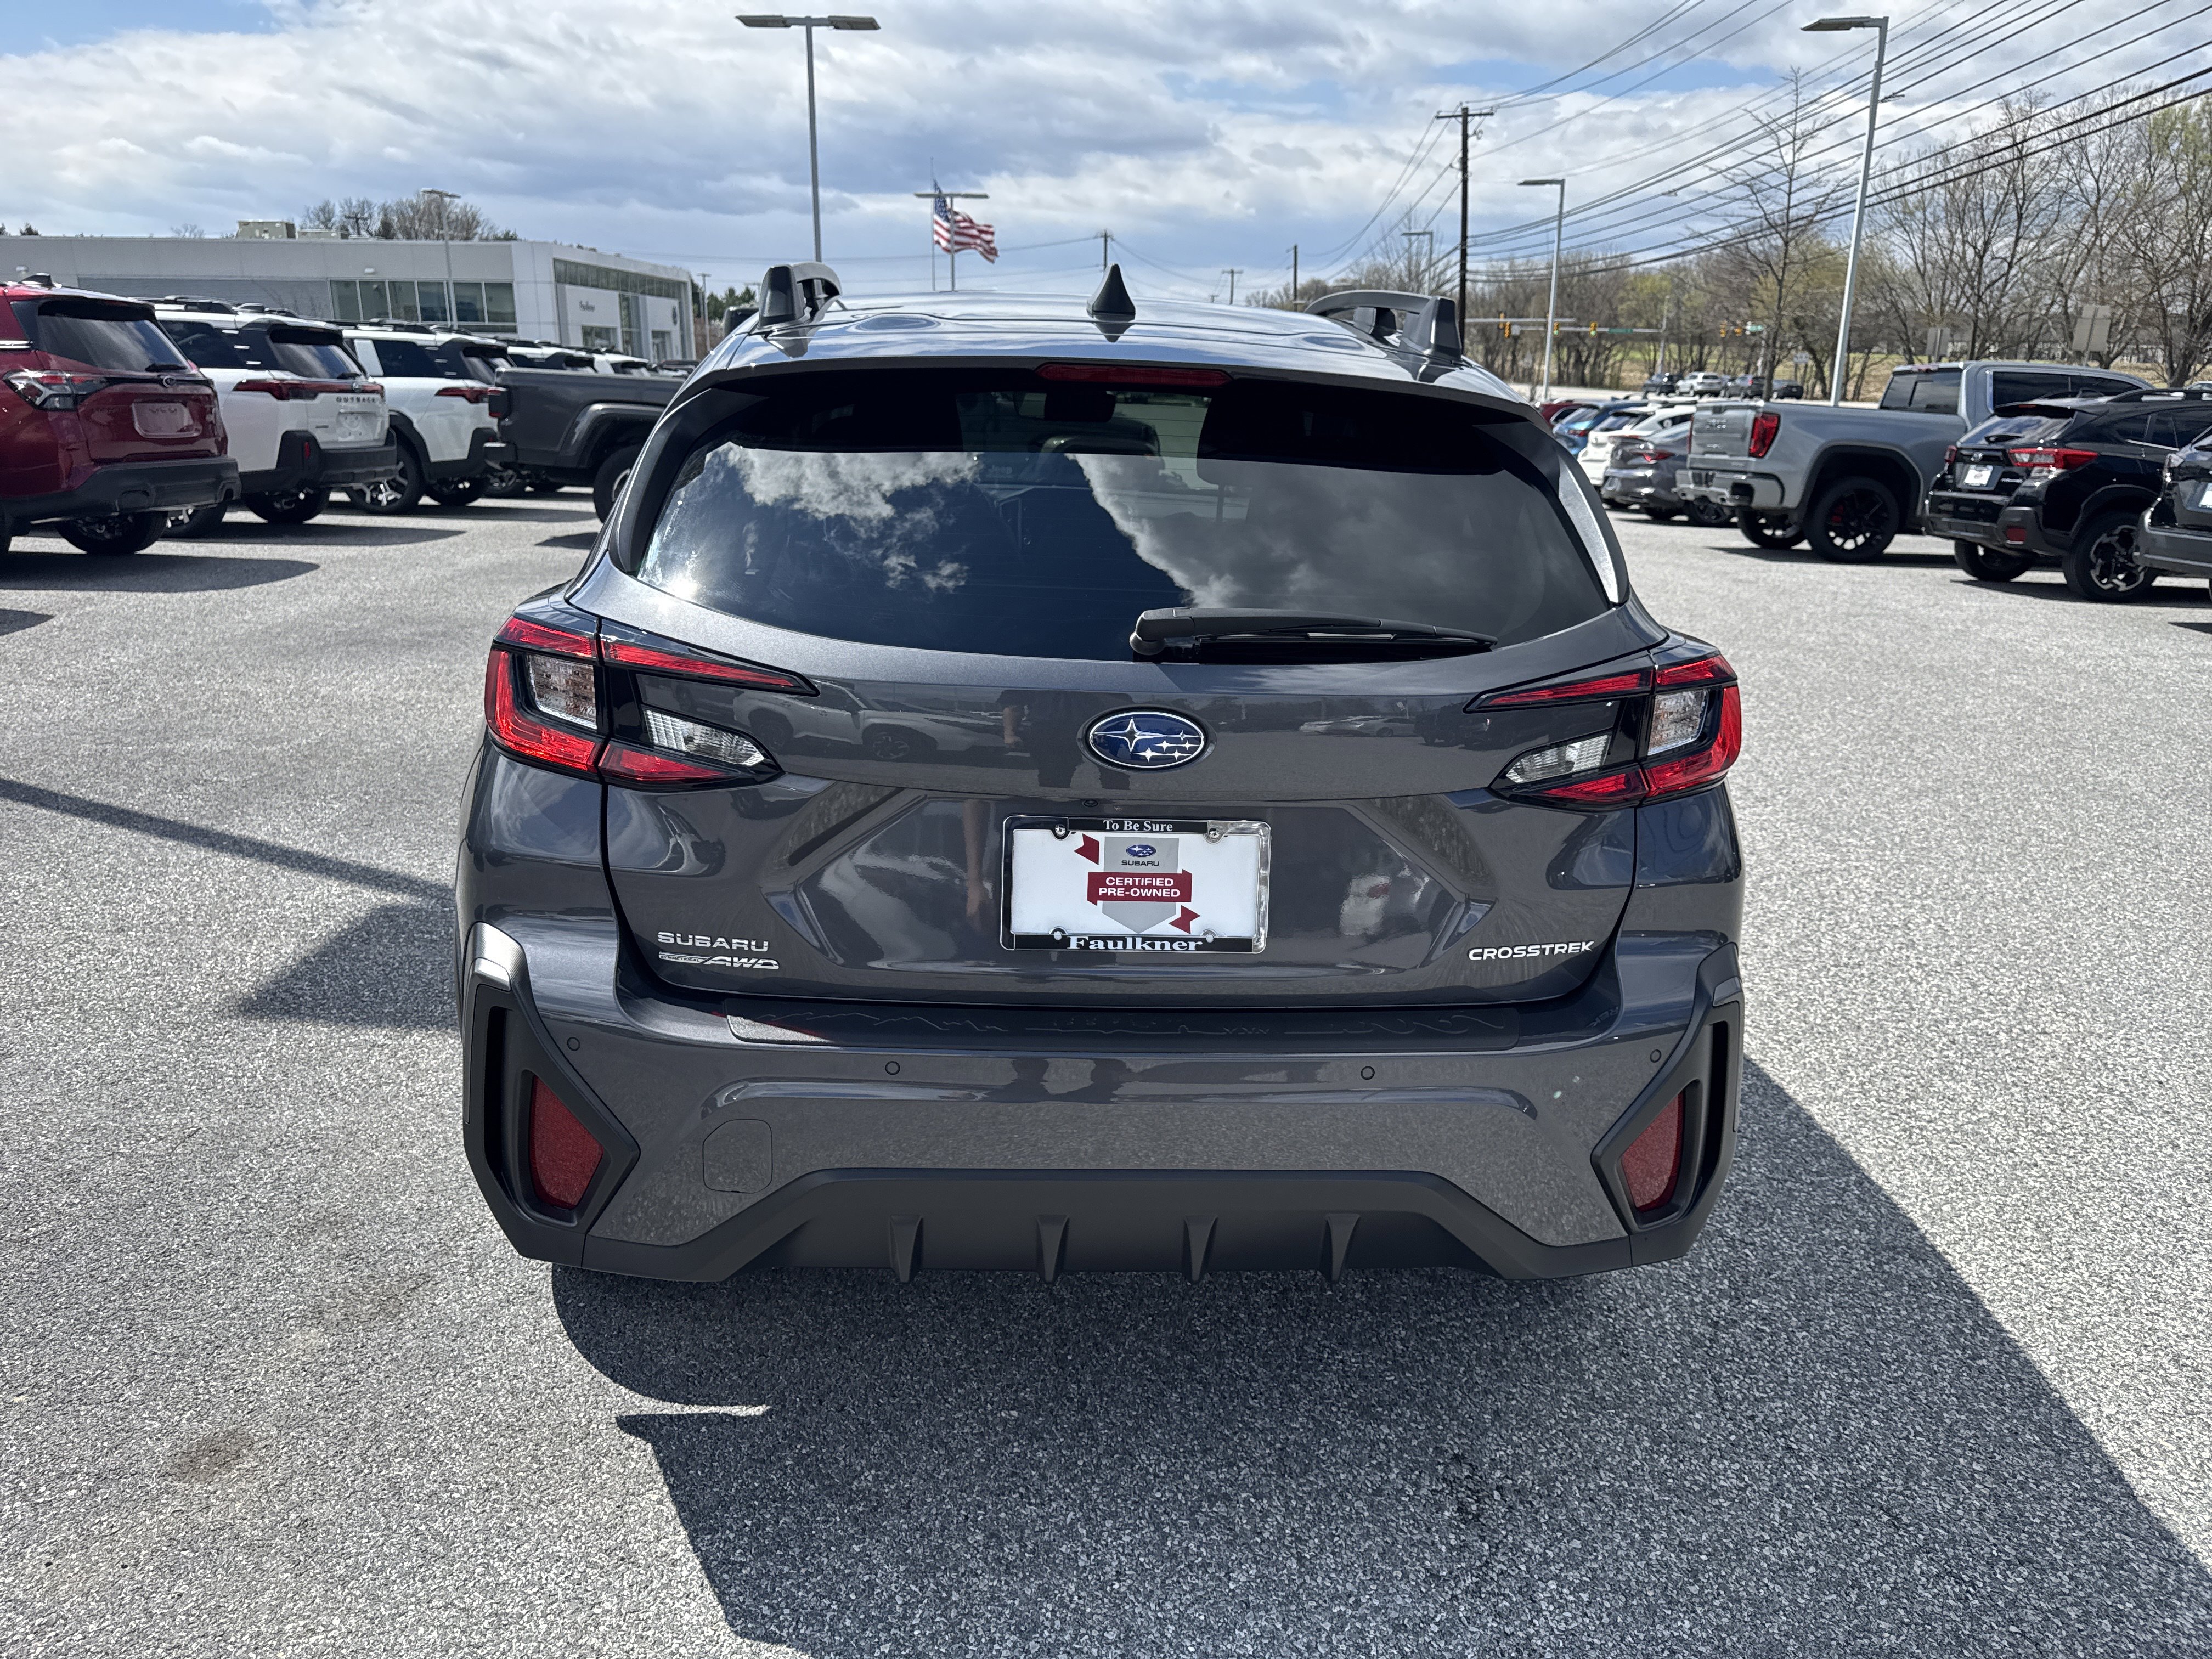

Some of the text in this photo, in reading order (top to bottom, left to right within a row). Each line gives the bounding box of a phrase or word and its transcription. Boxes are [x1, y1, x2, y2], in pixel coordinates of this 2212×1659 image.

[1103, 820, 1173, 832] To Be Sure
[1105, 877, 1174, 887] CERTIFIED
[1099, 887, 1180, 898] PRE-OWNED
[658, 931, 769, 952] SUBARU
[1066, 936, 1203, 951] Faulkner
[1469, 940, 1594, 961] CROSSTREK
[703, 956, 780, 970] AWD
